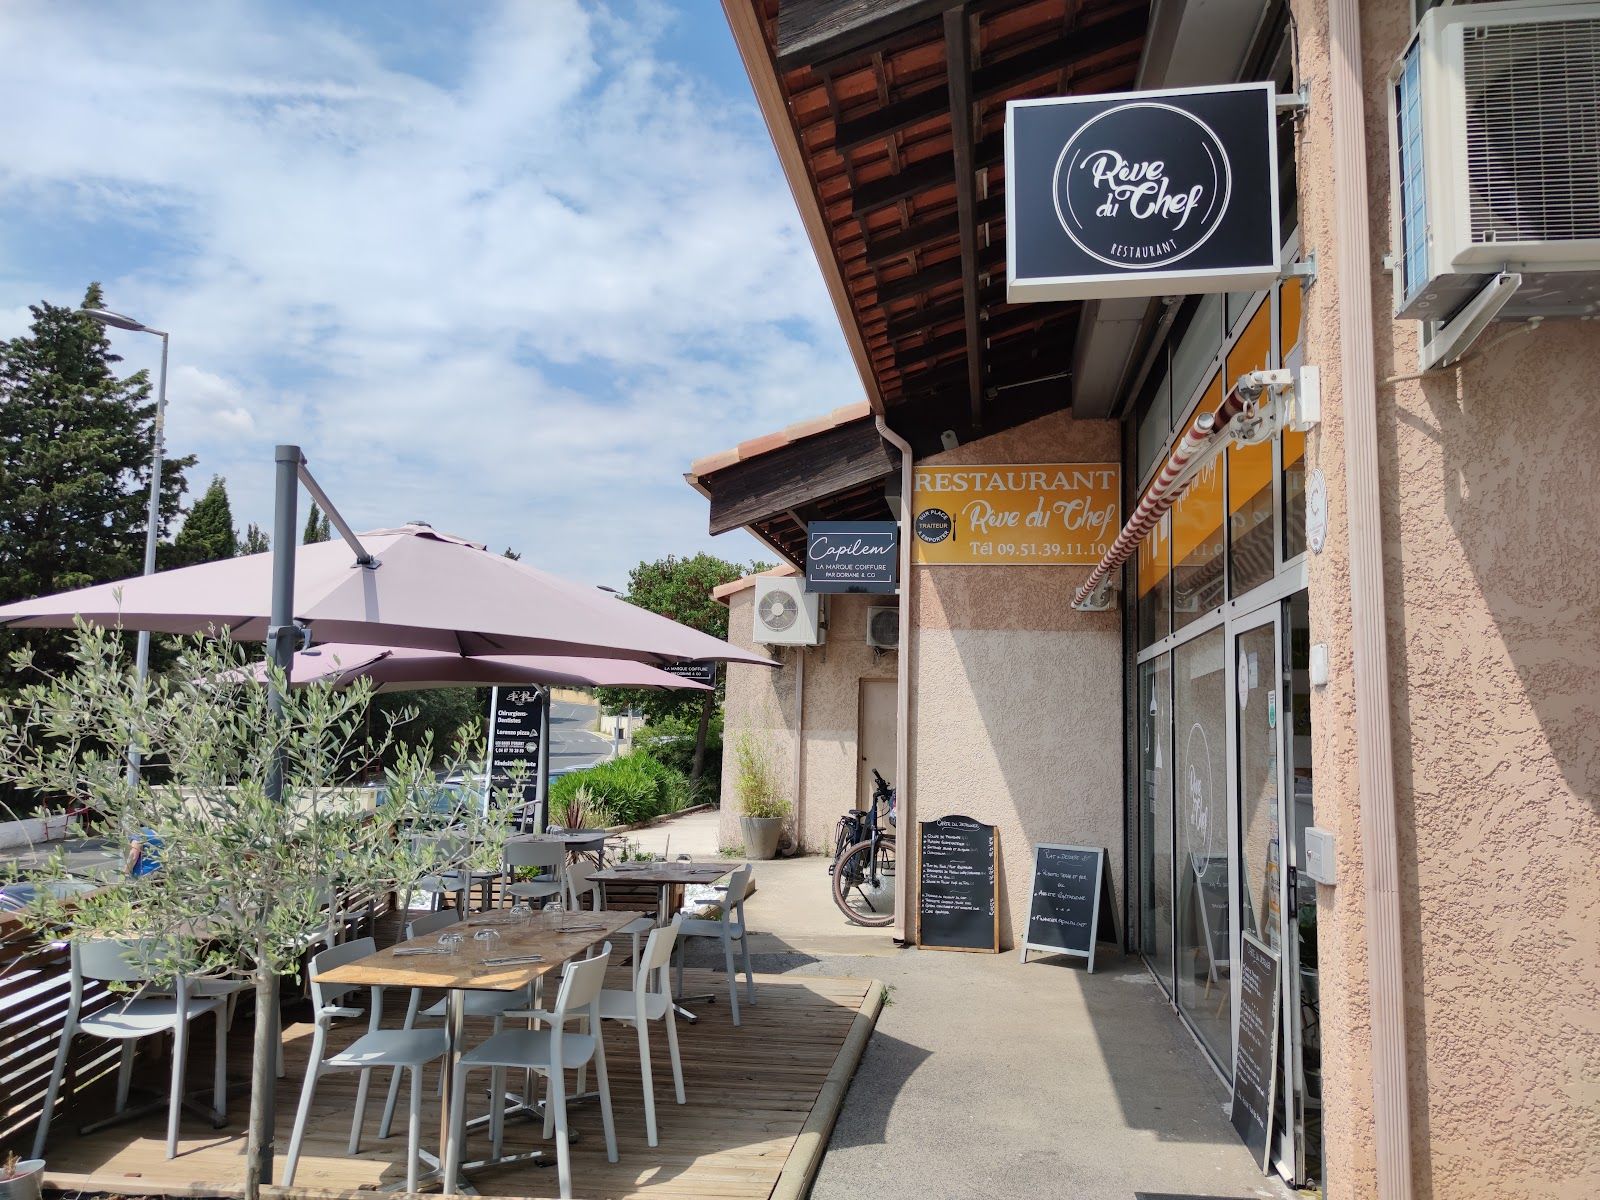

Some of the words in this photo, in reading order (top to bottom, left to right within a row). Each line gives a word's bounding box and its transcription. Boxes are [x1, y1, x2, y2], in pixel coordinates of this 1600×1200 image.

[1080, 150, 1165, 190] Rêve
[1096, 194, 1119, 218] du
[1115, 177, 1203, 231] Chef
[1110, 238, 1177, 258] RESTAURANT
[914, 471, 1115, 492] RESTAURANT
[919, 512, 930, 520] SUR
[930, 510, 948, 520] PLACE
[1025, 496, 1050, 528] du
[1053, 496, 1115, 541] Chef
[921, 530, 949, 542] EMPORTER
[809, 537, 895, 561] Capilem
[969, 541, 992, 556] Tél
[997, 543, 1107, 557] 09.51.39.11.10
